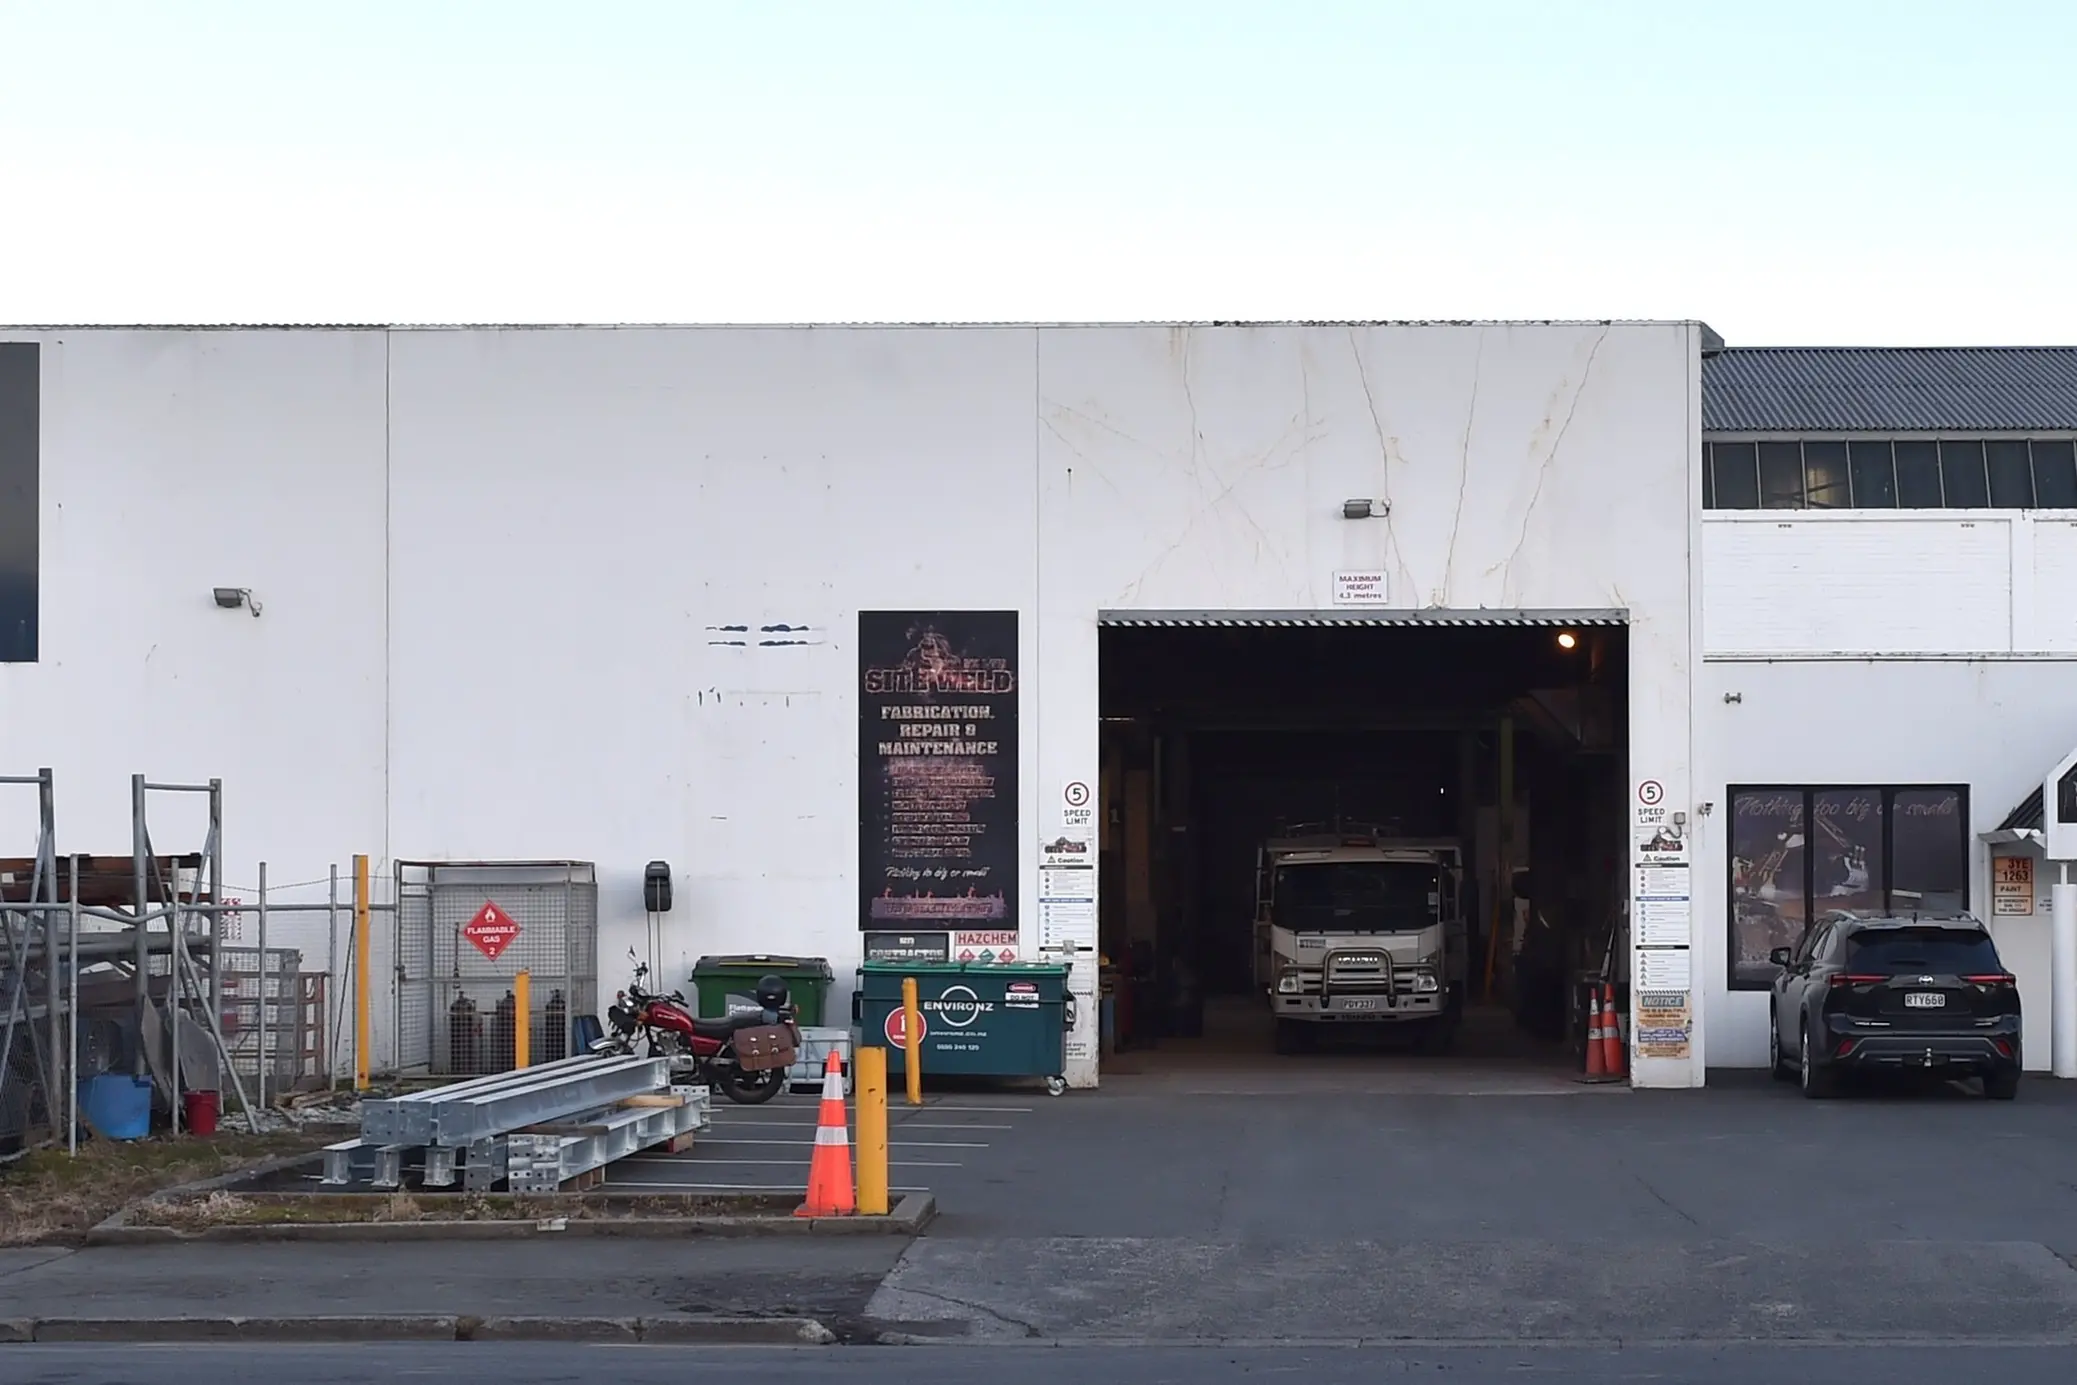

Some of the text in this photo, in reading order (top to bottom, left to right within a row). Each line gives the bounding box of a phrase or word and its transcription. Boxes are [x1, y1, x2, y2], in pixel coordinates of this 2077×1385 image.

[865, 669, 1014, 694] SITE WELD
[900, 723, 976, 737] REPAIR &
[879, 741, 998, 755] MAINTENANCE
[1073, 787, 1082, 801] 5
[1646, 786, 1656, 800] 5
[1064, 809, 1091, 817] SPEED
[1638, 808, 1665, 816] SPEED
[1735, 796, 1804, 822] Nothing
[1813, 797, 1840, 815] too
[1845, 796, 1871, 822] big
[1066, 817, 1088, 825] LIMIT
[1640, 816, 1663, 824] LIMIT
[2008, 859, 2029, 869] 3YE
[934, 866, 949, 881] big
[2003, 870, 2029, 881] 1263
[467, 926, 516, 934] FLAMMABLE
[483, 935, 500, 943] GAS
[958, 933, 1017, 944] HAZCHEM
[489, 947, 496, 955] 2
[924, 1001, 995, 1012] ENVIRONZ
[1643, 997, 1682, 1006] NOTICE
